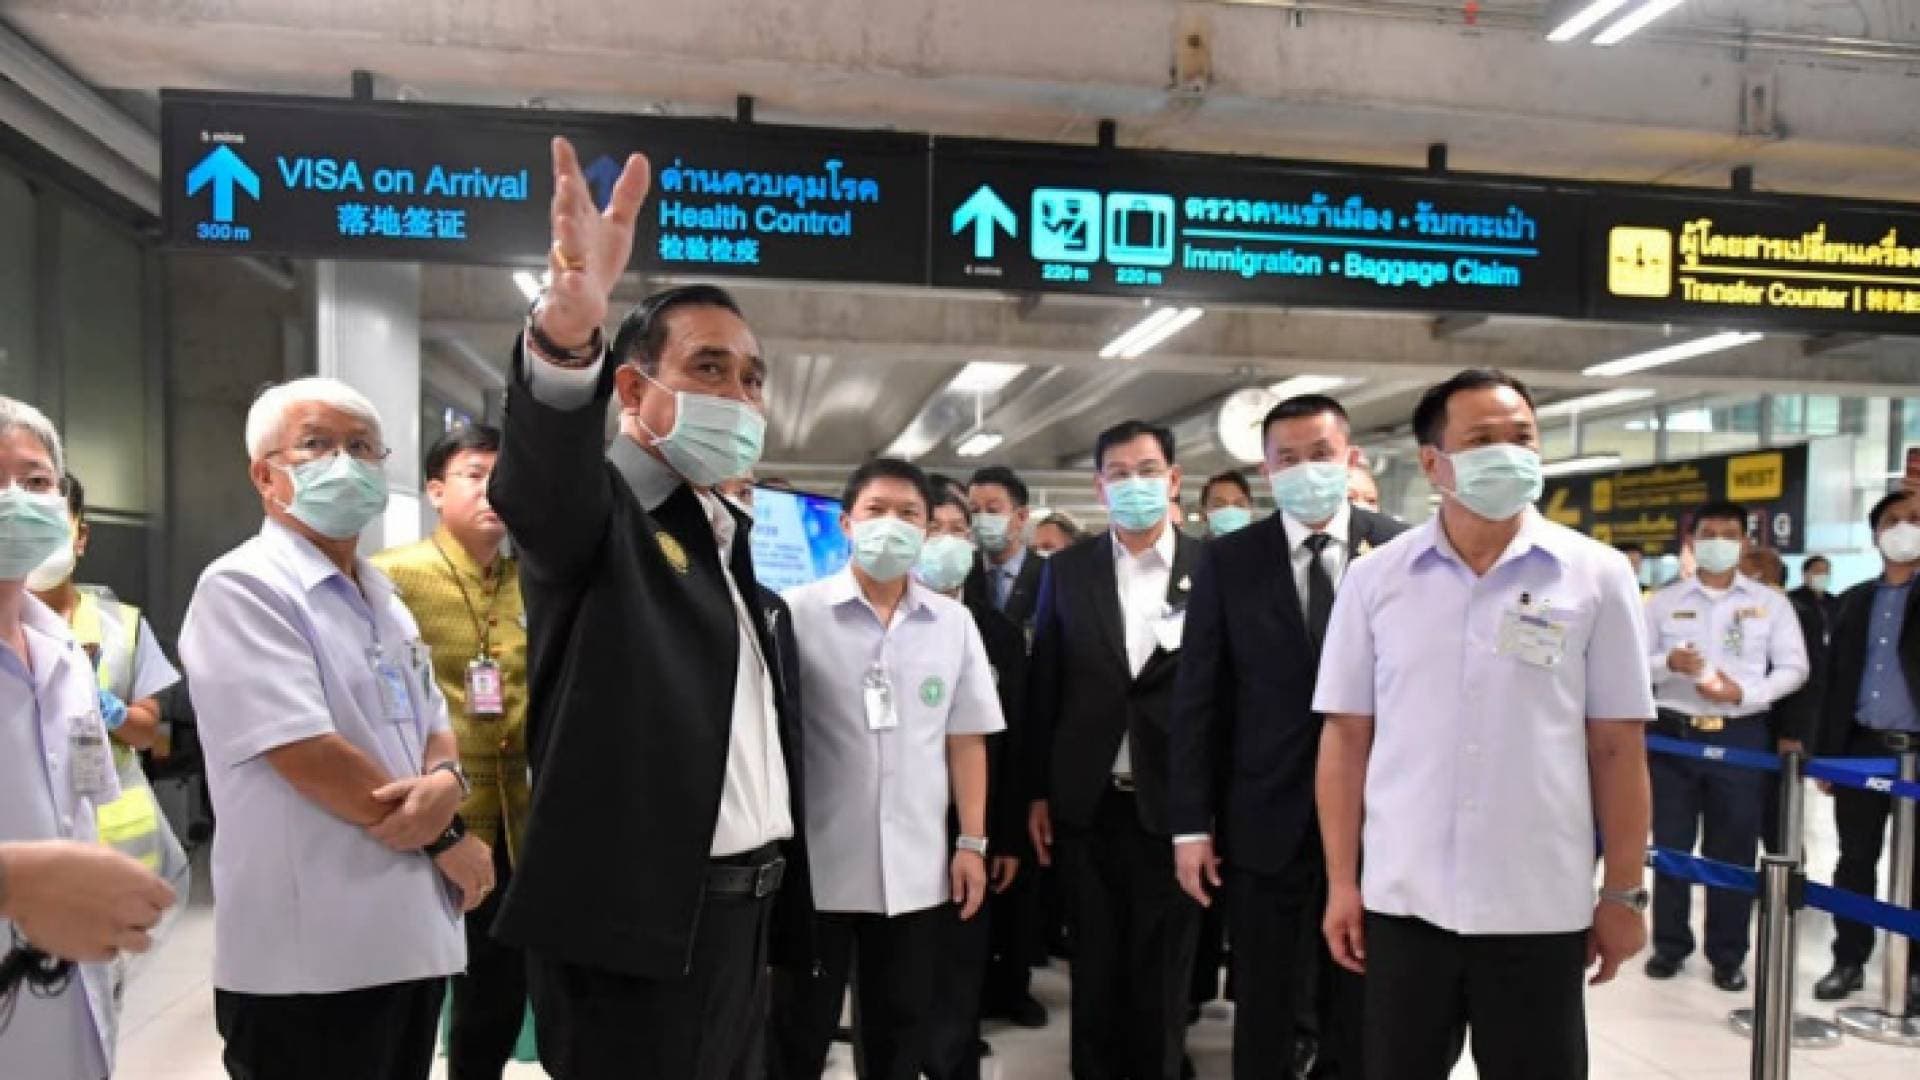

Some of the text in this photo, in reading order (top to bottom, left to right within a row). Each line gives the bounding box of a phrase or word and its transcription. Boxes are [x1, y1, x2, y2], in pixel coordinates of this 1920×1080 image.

[277, 156, 528, 200] VISA on Arrival
[660, 158, 879, 208] ด่านควบคุมโรค
[336, 203, 467, 239] 落地签证
[659, 200, 851, 235] Health Control
[1183, 243, 1520, 288] Immigration Baggage Claim
[1679, 278, 1848, 309] Transfer Counter
[1735, 467, 1776, 488] WEST
